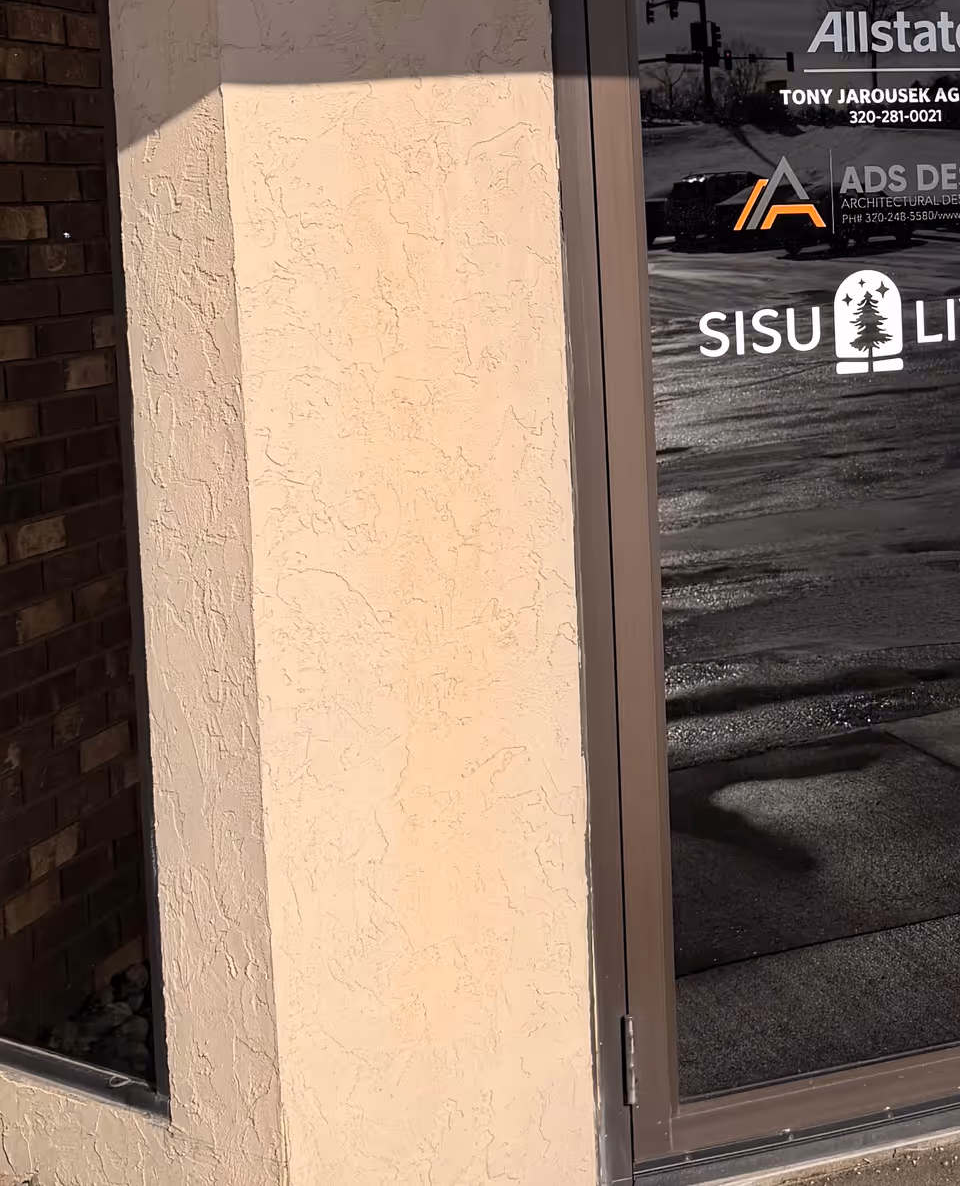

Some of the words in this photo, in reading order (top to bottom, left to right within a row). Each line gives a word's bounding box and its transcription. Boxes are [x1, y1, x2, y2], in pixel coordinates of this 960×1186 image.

[779, 89, 833, 105] TONY
[837, 87, 931, 104] JAROUSEK
[849, 108, 943, 124] 320-281-0021
[839, 164, 908, 194] ADS
[841, 195, 940, 209] ARCHITECTURAL
[841, 213, 863, 224] PH#
[698, 306, 822, 357] SISU
